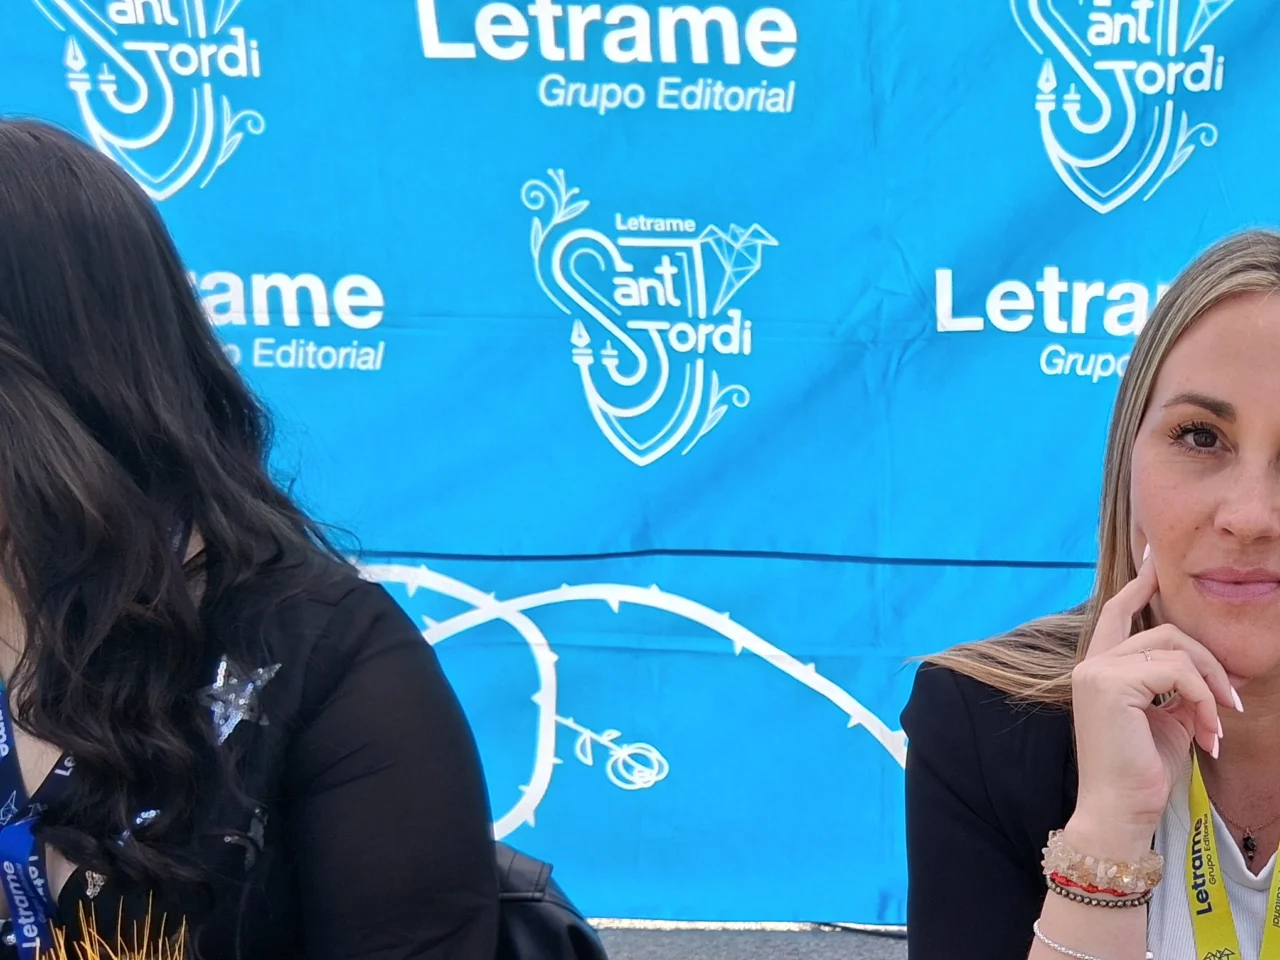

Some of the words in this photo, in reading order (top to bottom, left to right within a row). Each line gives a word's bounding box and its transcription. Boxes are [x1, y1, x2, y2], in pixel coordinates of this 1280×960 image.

[415, 0, 798, 68] Letrame
[538, 73, 646, 115] Grupo
[656, 77, 796, 113] Editorial
[614, 212, 697, 233] Letrame
[935, 265, 1170, 337] Letra
[252, 337, 386, 371] Editorial
[1191, 817, 1213, 916] Letrame
[1207, 854, 1217, 885] Grupo
[3, 861, 40, 949] Letrame
